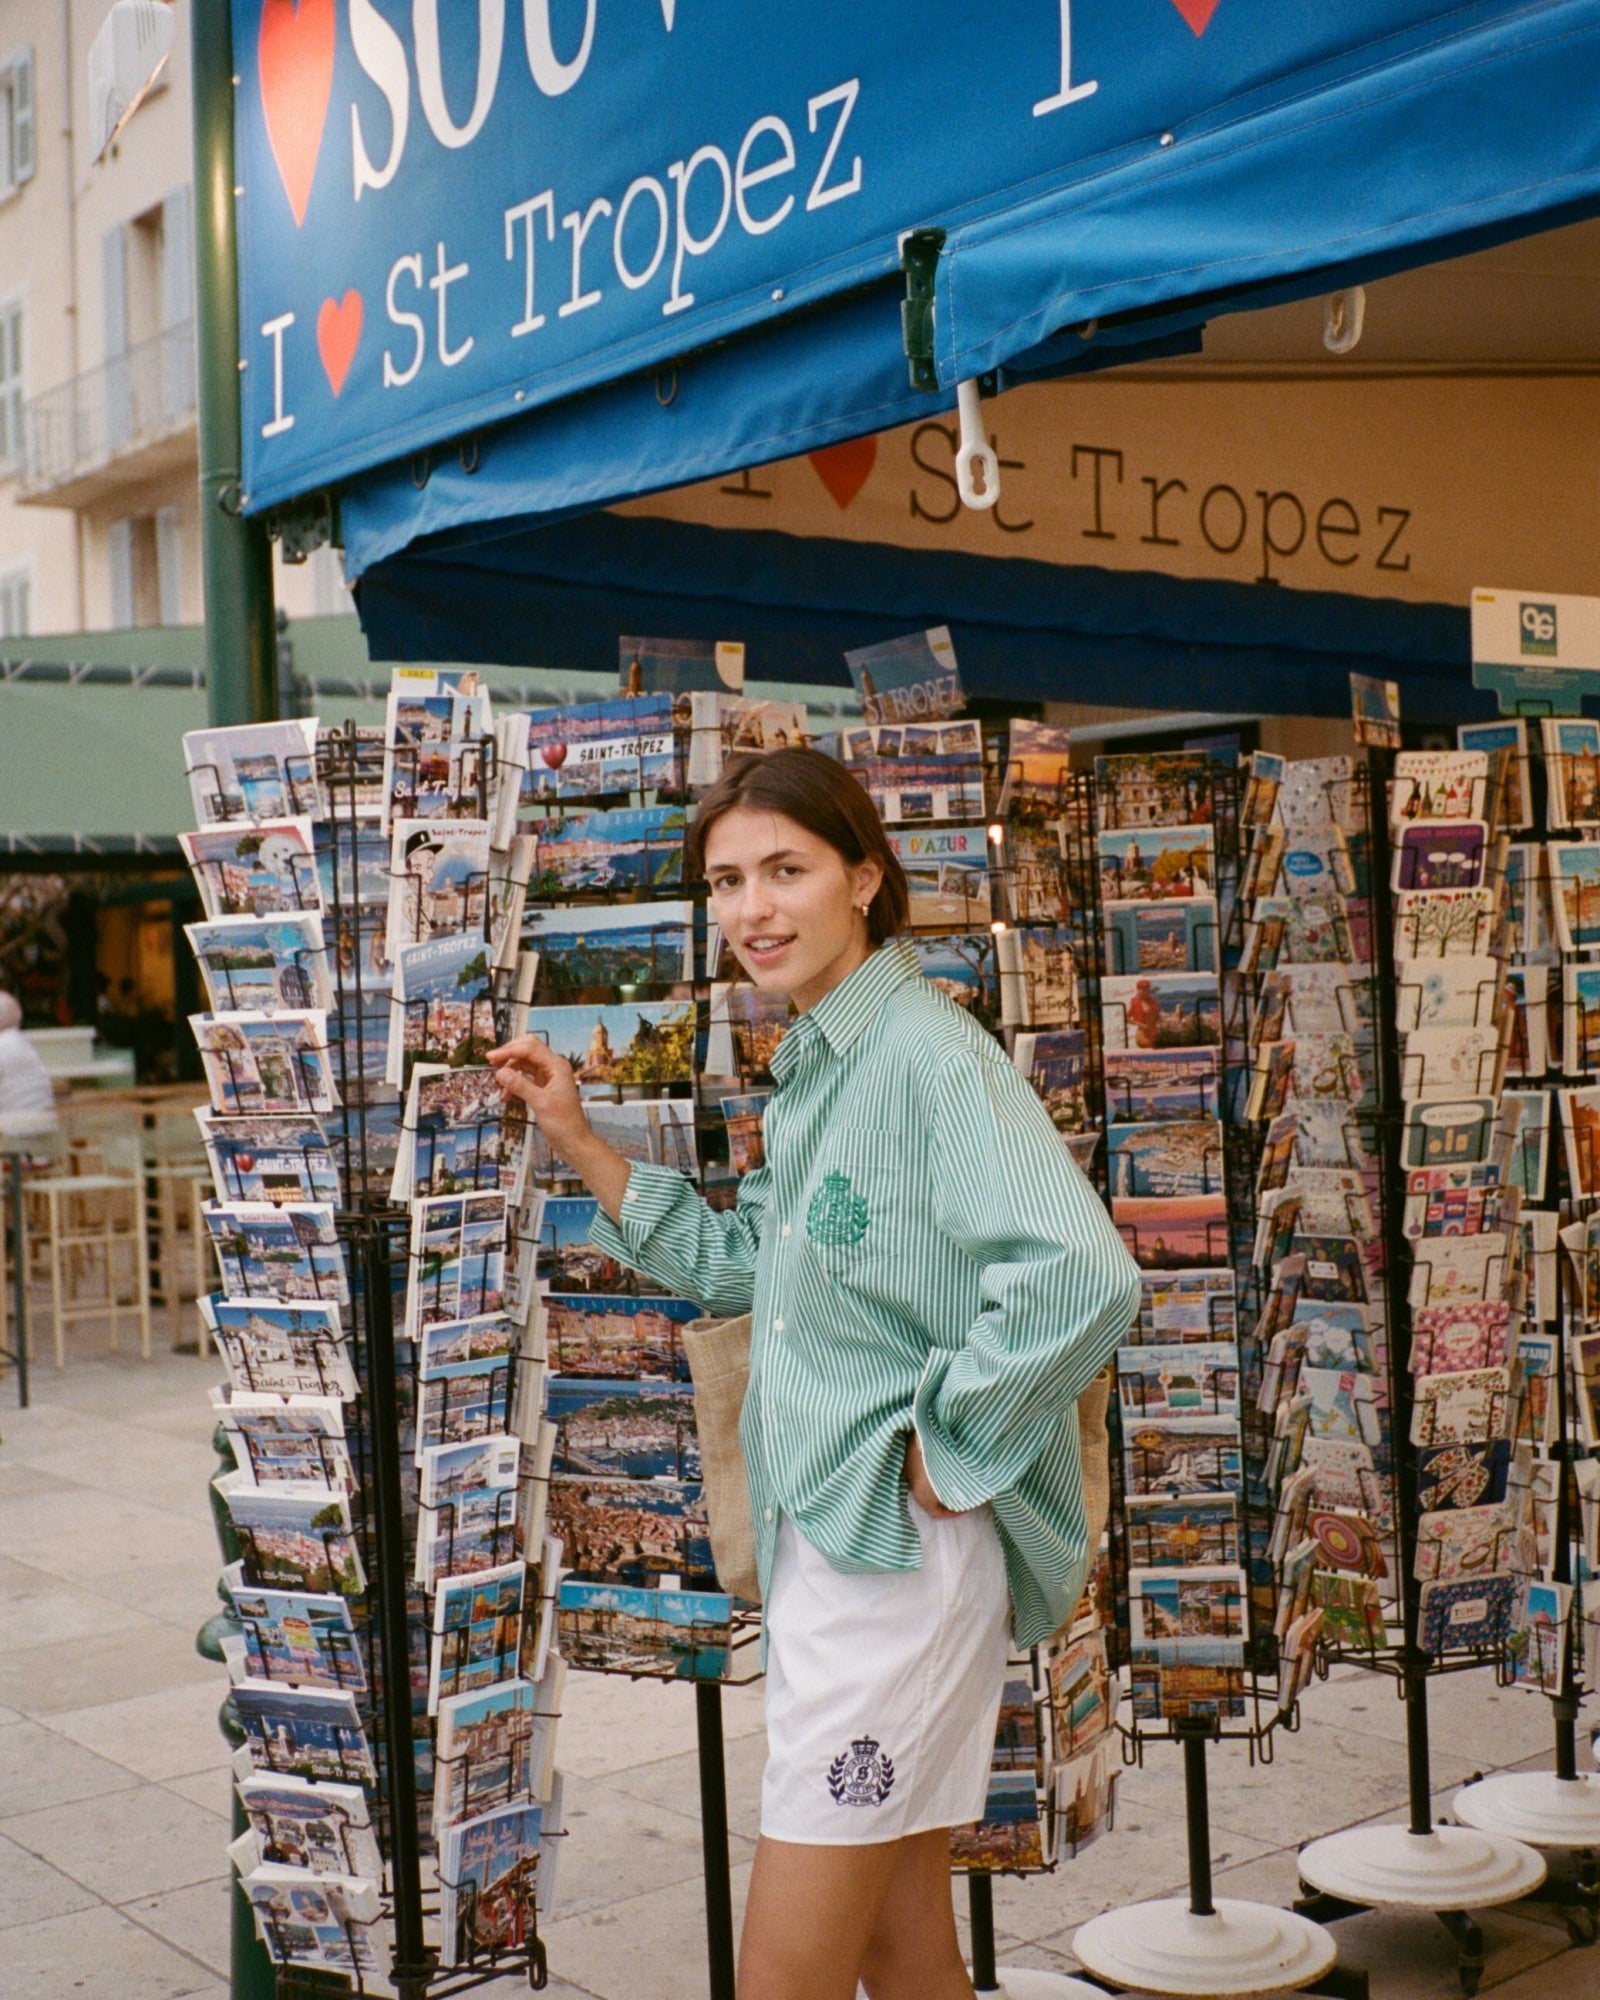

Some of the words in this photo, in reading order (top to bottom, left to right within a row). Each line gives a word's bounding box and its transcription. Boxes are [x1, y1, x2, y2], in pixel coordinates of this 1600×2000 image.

[260, 311, 296, 438] I
[382, 242, 474, 388] St
[504, 77, 862, 338] Tropez
[1071, 444, 1412, 586] Tropez
[887, 674, 957, 722] TROPEZ
[579, 739, 665, 762] SAINT-TROPEZ
[909, 834, 968, 856] D'AZUR
[239, 1371, 285, 1389] Saint
[285, 1375, 345, 1397] Tropez
